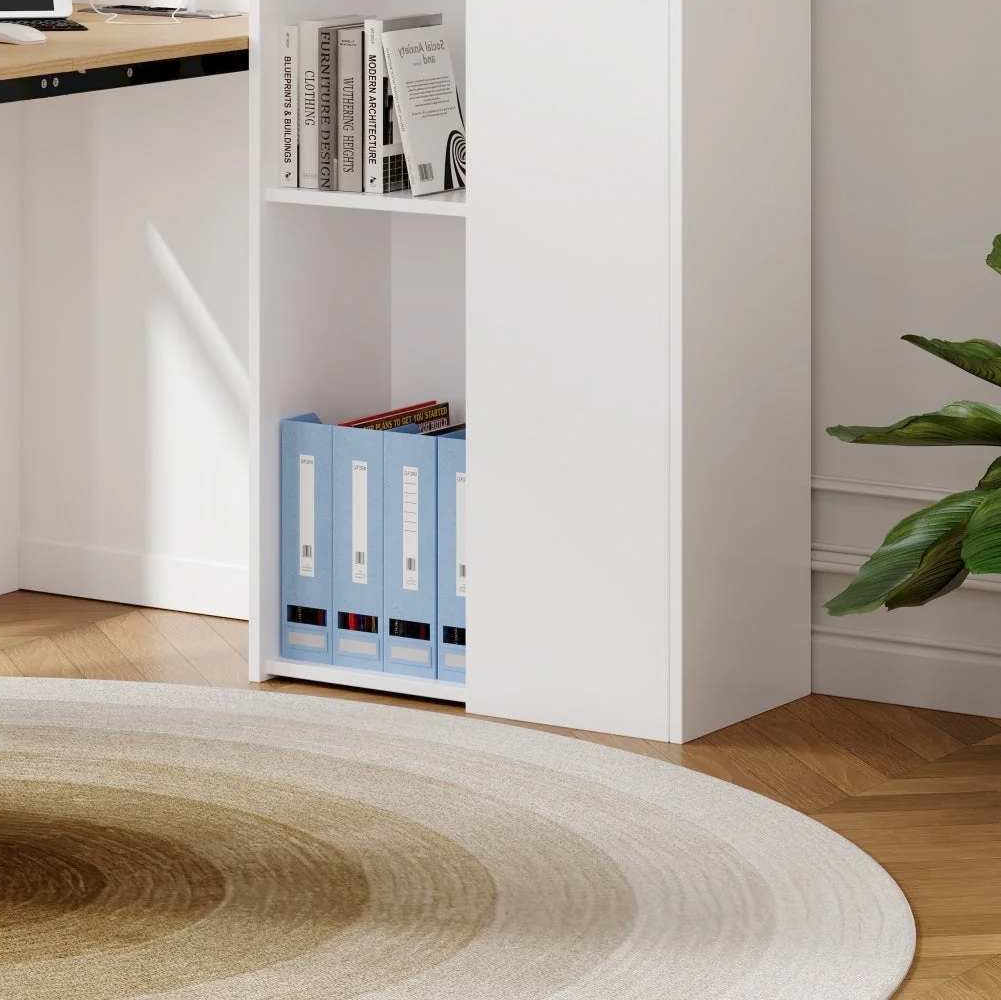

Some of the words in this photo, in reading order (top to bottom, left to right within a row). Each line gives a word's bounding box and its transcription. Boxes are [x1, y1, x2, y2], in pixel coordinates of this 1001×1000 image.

[304, 70, 315, 126] CLOTHING
[320, 31, 330, 125] FURNITURE
[368, 54, 376, 95] MODERN
[343, 77, 354, 131] WUTHERING
[368, 96, 376, 165] ARCHITECTURE
[320, 130, 330, 189] DESIGN
[343, 135, 354, 173] HEIGHTS
[375, 420, 393, 430] PLANS
[393, 419, 401, 428] TO
[401, 415, 412, 425] GET
[412, 411, 424, 422] YOU
[424, 406, 448, 420] STARTED
[430, 418, 448, 429] BUILD
